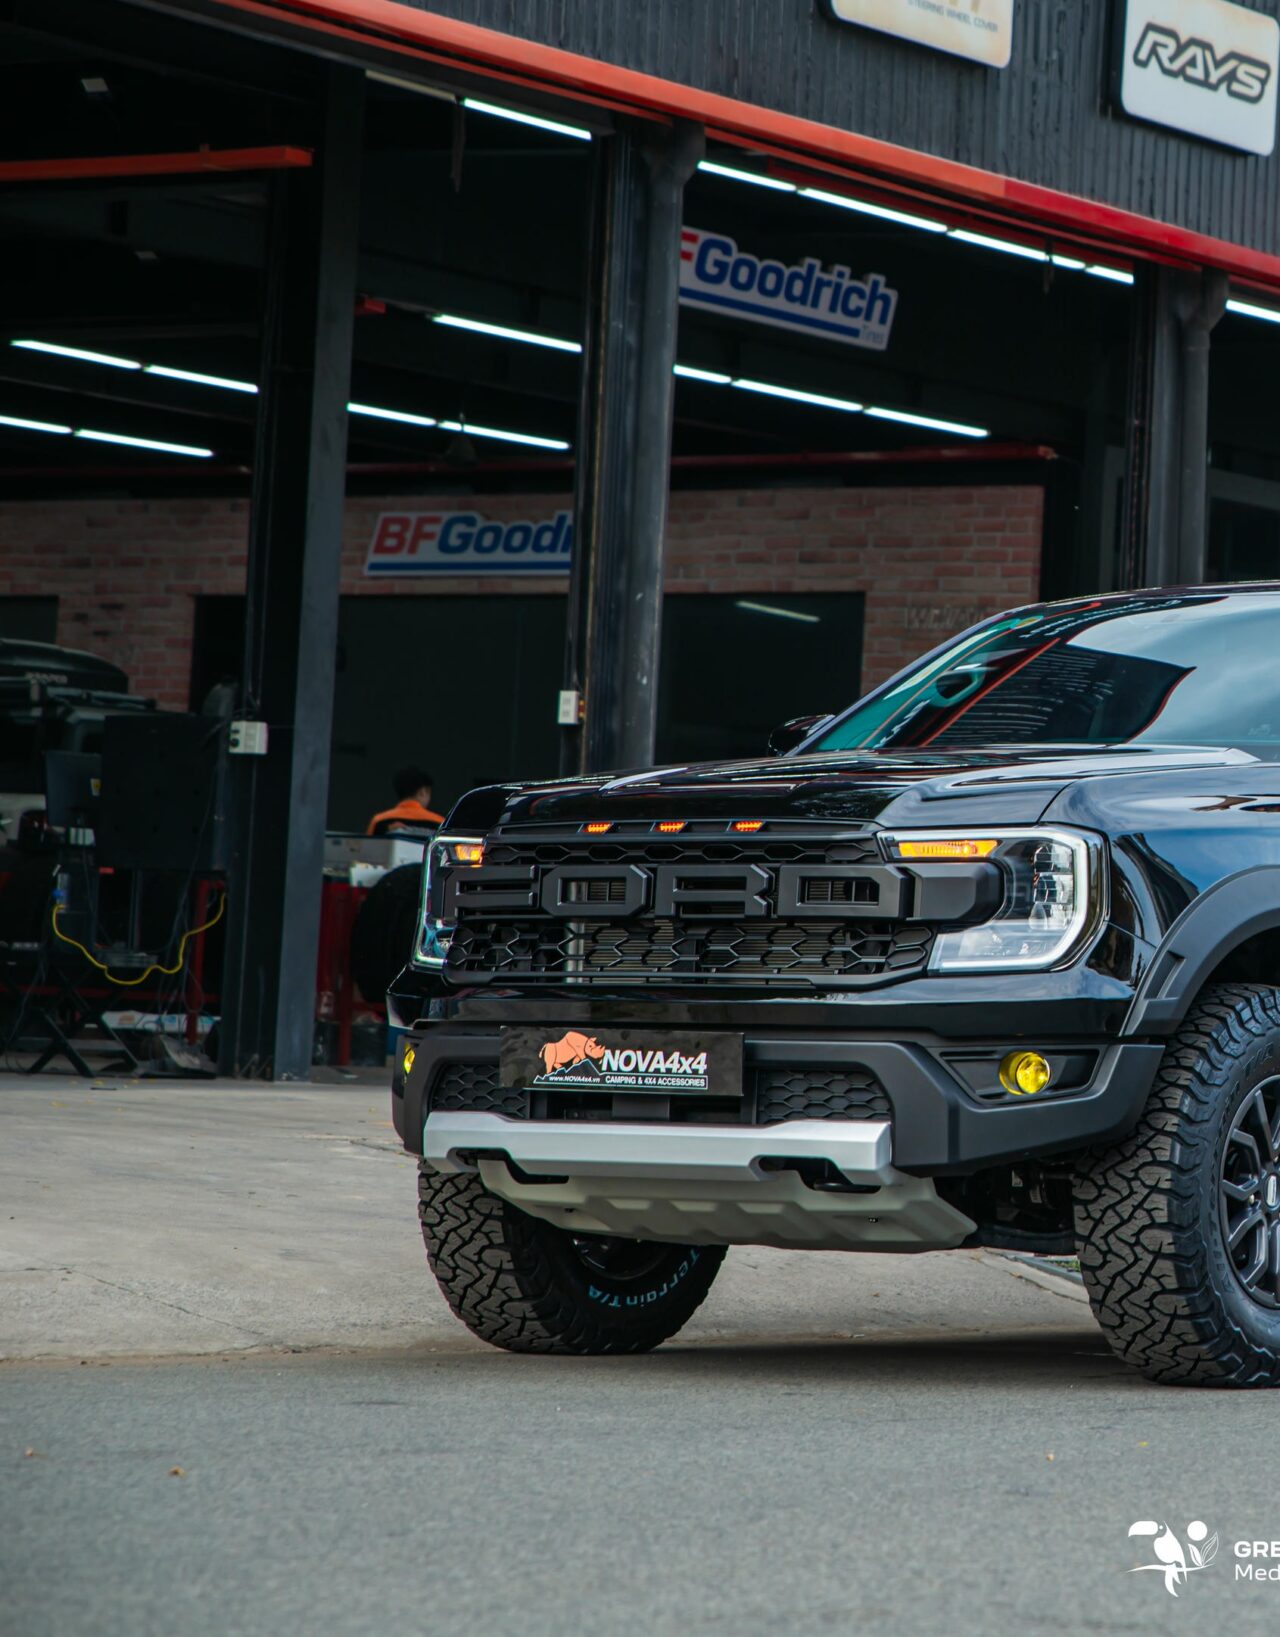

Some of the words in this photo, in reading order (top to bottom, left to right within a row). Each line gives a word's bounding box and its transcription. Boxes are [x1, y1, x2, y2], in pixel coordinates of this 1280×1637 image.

[1133, 22, 1271, 104] RAYS
[372, 513, 572, 555] BFGood
[430, 862, 914, 922] FORD
[601, 1050, 708, 1074] NOVA4x4
[605, 1075, 637, 1085] CAMPING
[638, 1077, 643, 1085] &
[657, 1077, 706, 1087] ACCESSORIES
[588, 1284, 622, 1307] T/A
